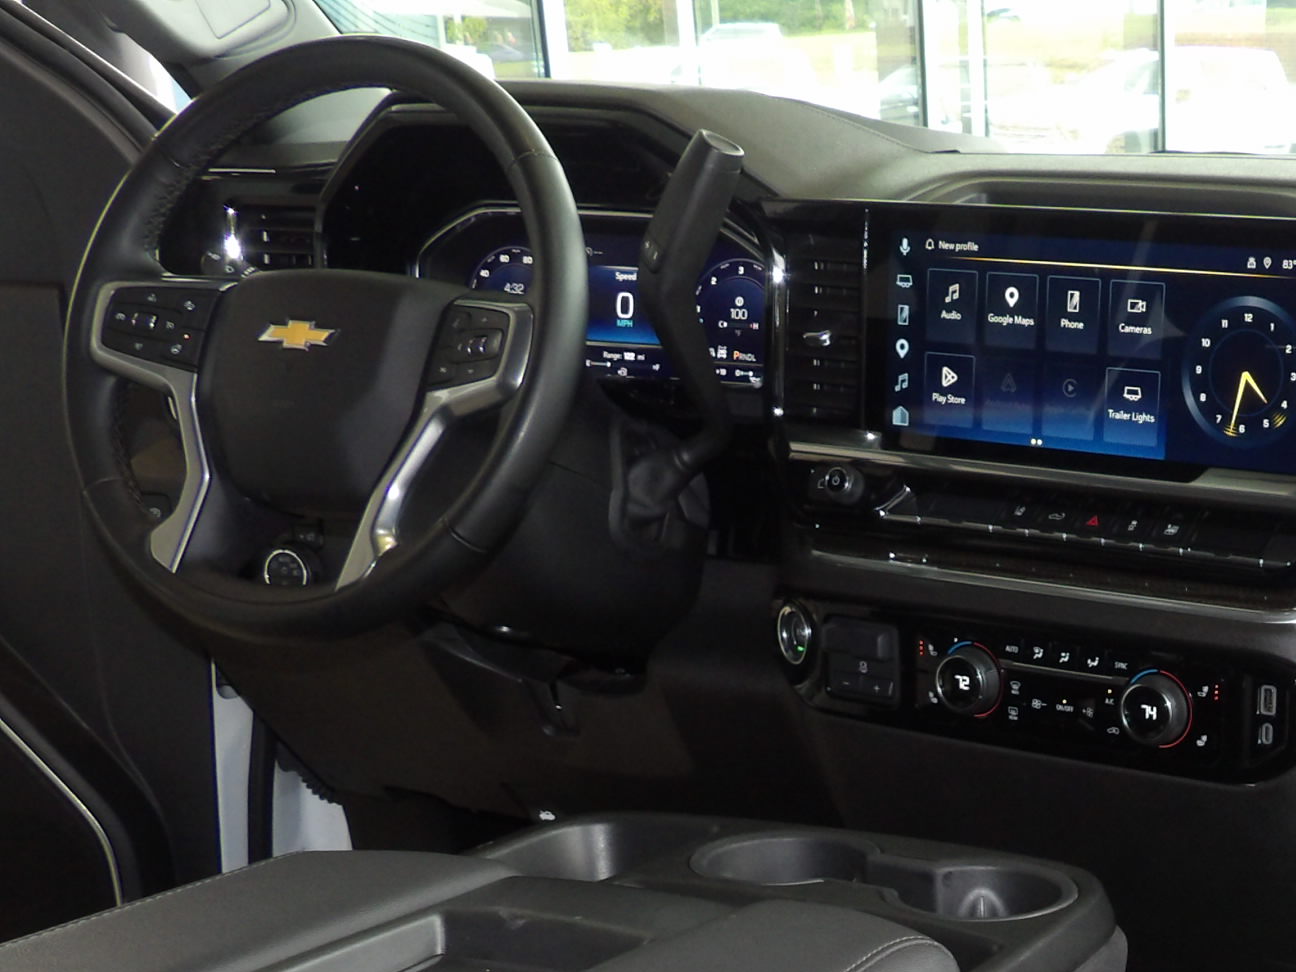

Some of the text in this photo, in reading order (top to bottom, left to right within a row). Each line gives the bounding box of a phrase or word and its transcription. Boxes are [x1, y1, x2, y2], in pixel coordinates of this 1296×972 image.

[938, 240, 979, 252] New profile
[615, 272, 637, 282] Speed
[616, 292, 634, 319] 0
[730, 308, 748, 320] 100
[941, 310, 962, 321] Audio
[1244, 313, 1253, 322] 12
[616, 319, 633, 328] MPH
[987, 313, 1035, 327] Google Maps
[1060, 319, 1084, 330] Phone
[1221, 320, 1229, 329] 11
[1119, 323, 1152, 335] Cameras
[1270, 323, 1275, 332] 1
[1201, 338, 1211, 347] 10
[1285, 345, 1292, 354] 2
[1196, 365, 1202, 374] 9
[1290, 373, 1296, 381] 3
[932, 393, 966, 405] Play Store
[1200, 393, 1206, 402] 8
[1281, 400, 1288, 409] 4
[1108, 409, 1131, 421] Trailer
[1132, 412, 1155, 424] Lights
[1216, 415, 1222, 424] 7
[1263, 419, 1270, 428] 5
[1239, 425, 1245, 433] 6
[1005, 645, 1019, 654] AUTO
[954, 675, 970, 691] 72
[1055, 703, 1074, 713] ON/OFF
[1140, 704, 1157, 720] 74
